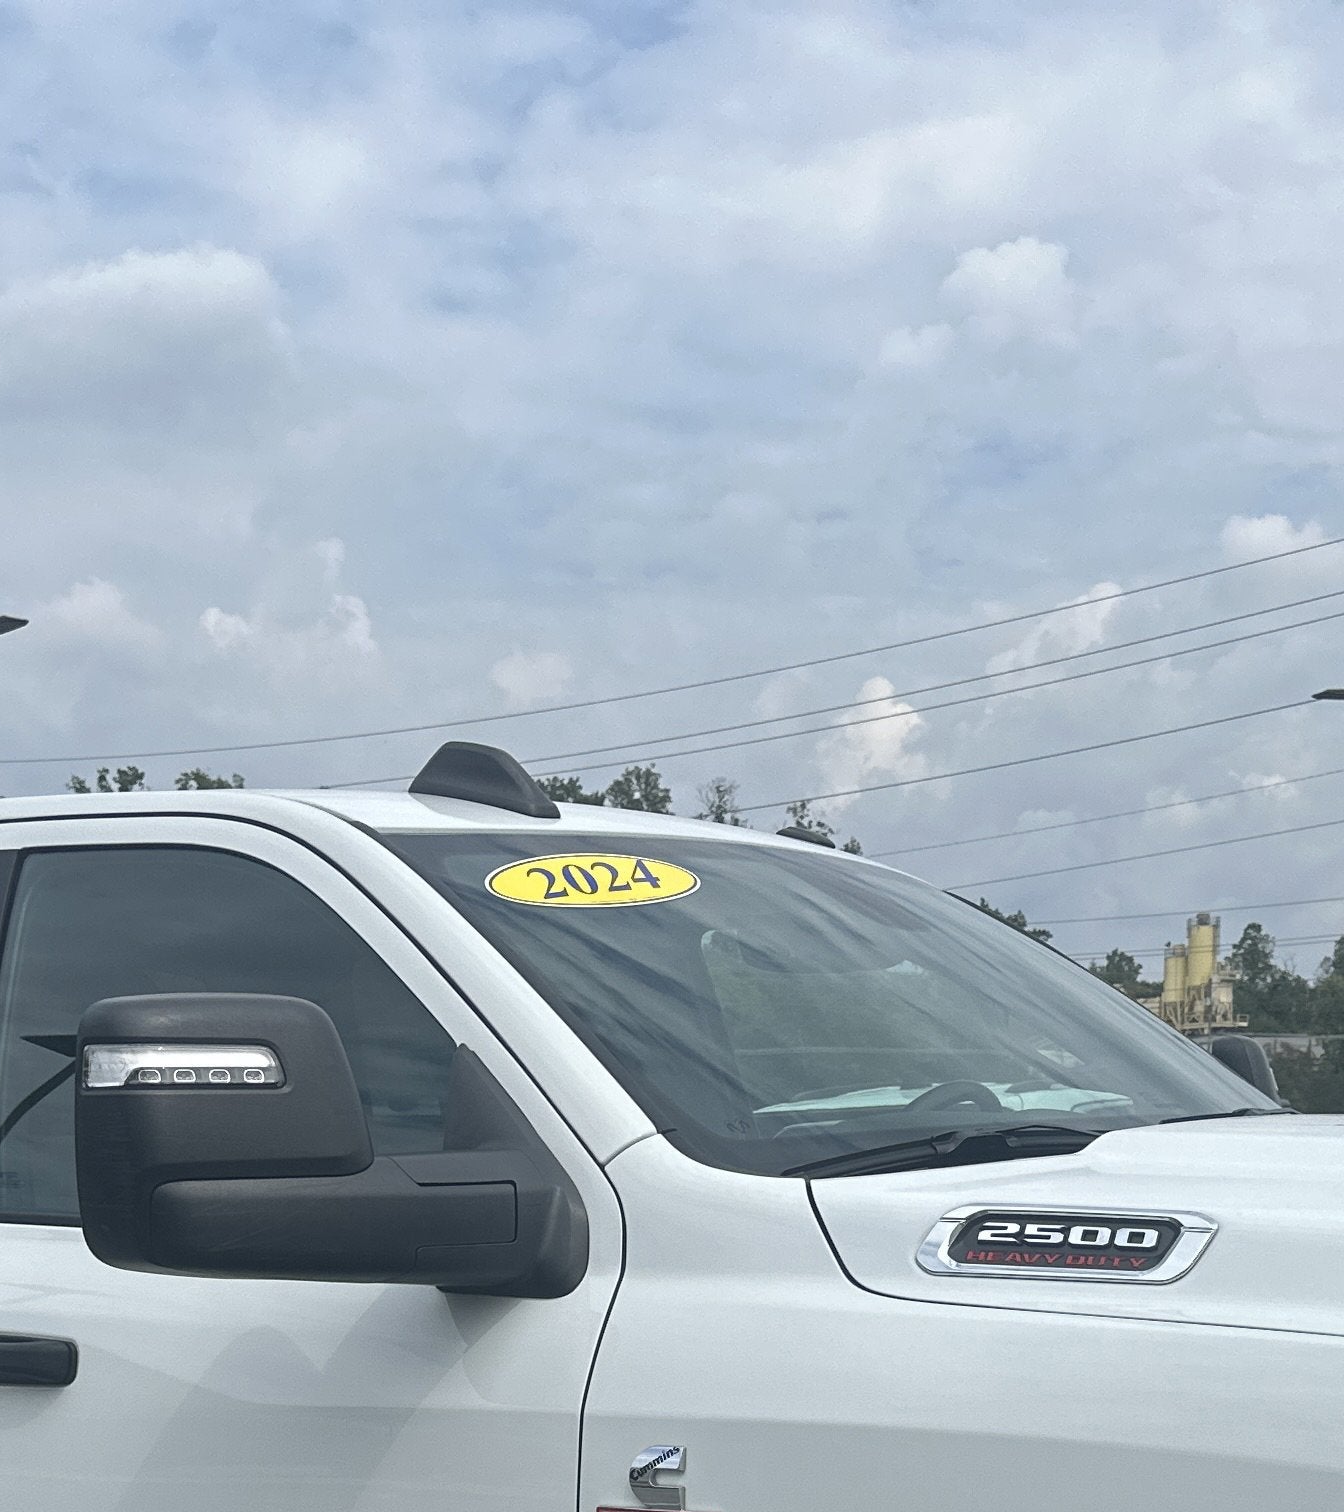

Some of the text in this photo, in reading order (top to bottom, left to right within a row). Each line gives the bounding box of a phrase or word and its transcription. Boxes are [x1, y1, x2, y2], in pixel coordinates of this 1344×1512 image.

[526, 859, 661, 899] 2024
[977, 1221, 1159, 1249] 2500
[966, 1250, 1148, 1269] HEAVY DUTY
[630, 1446, 680, 1481] Cummins
